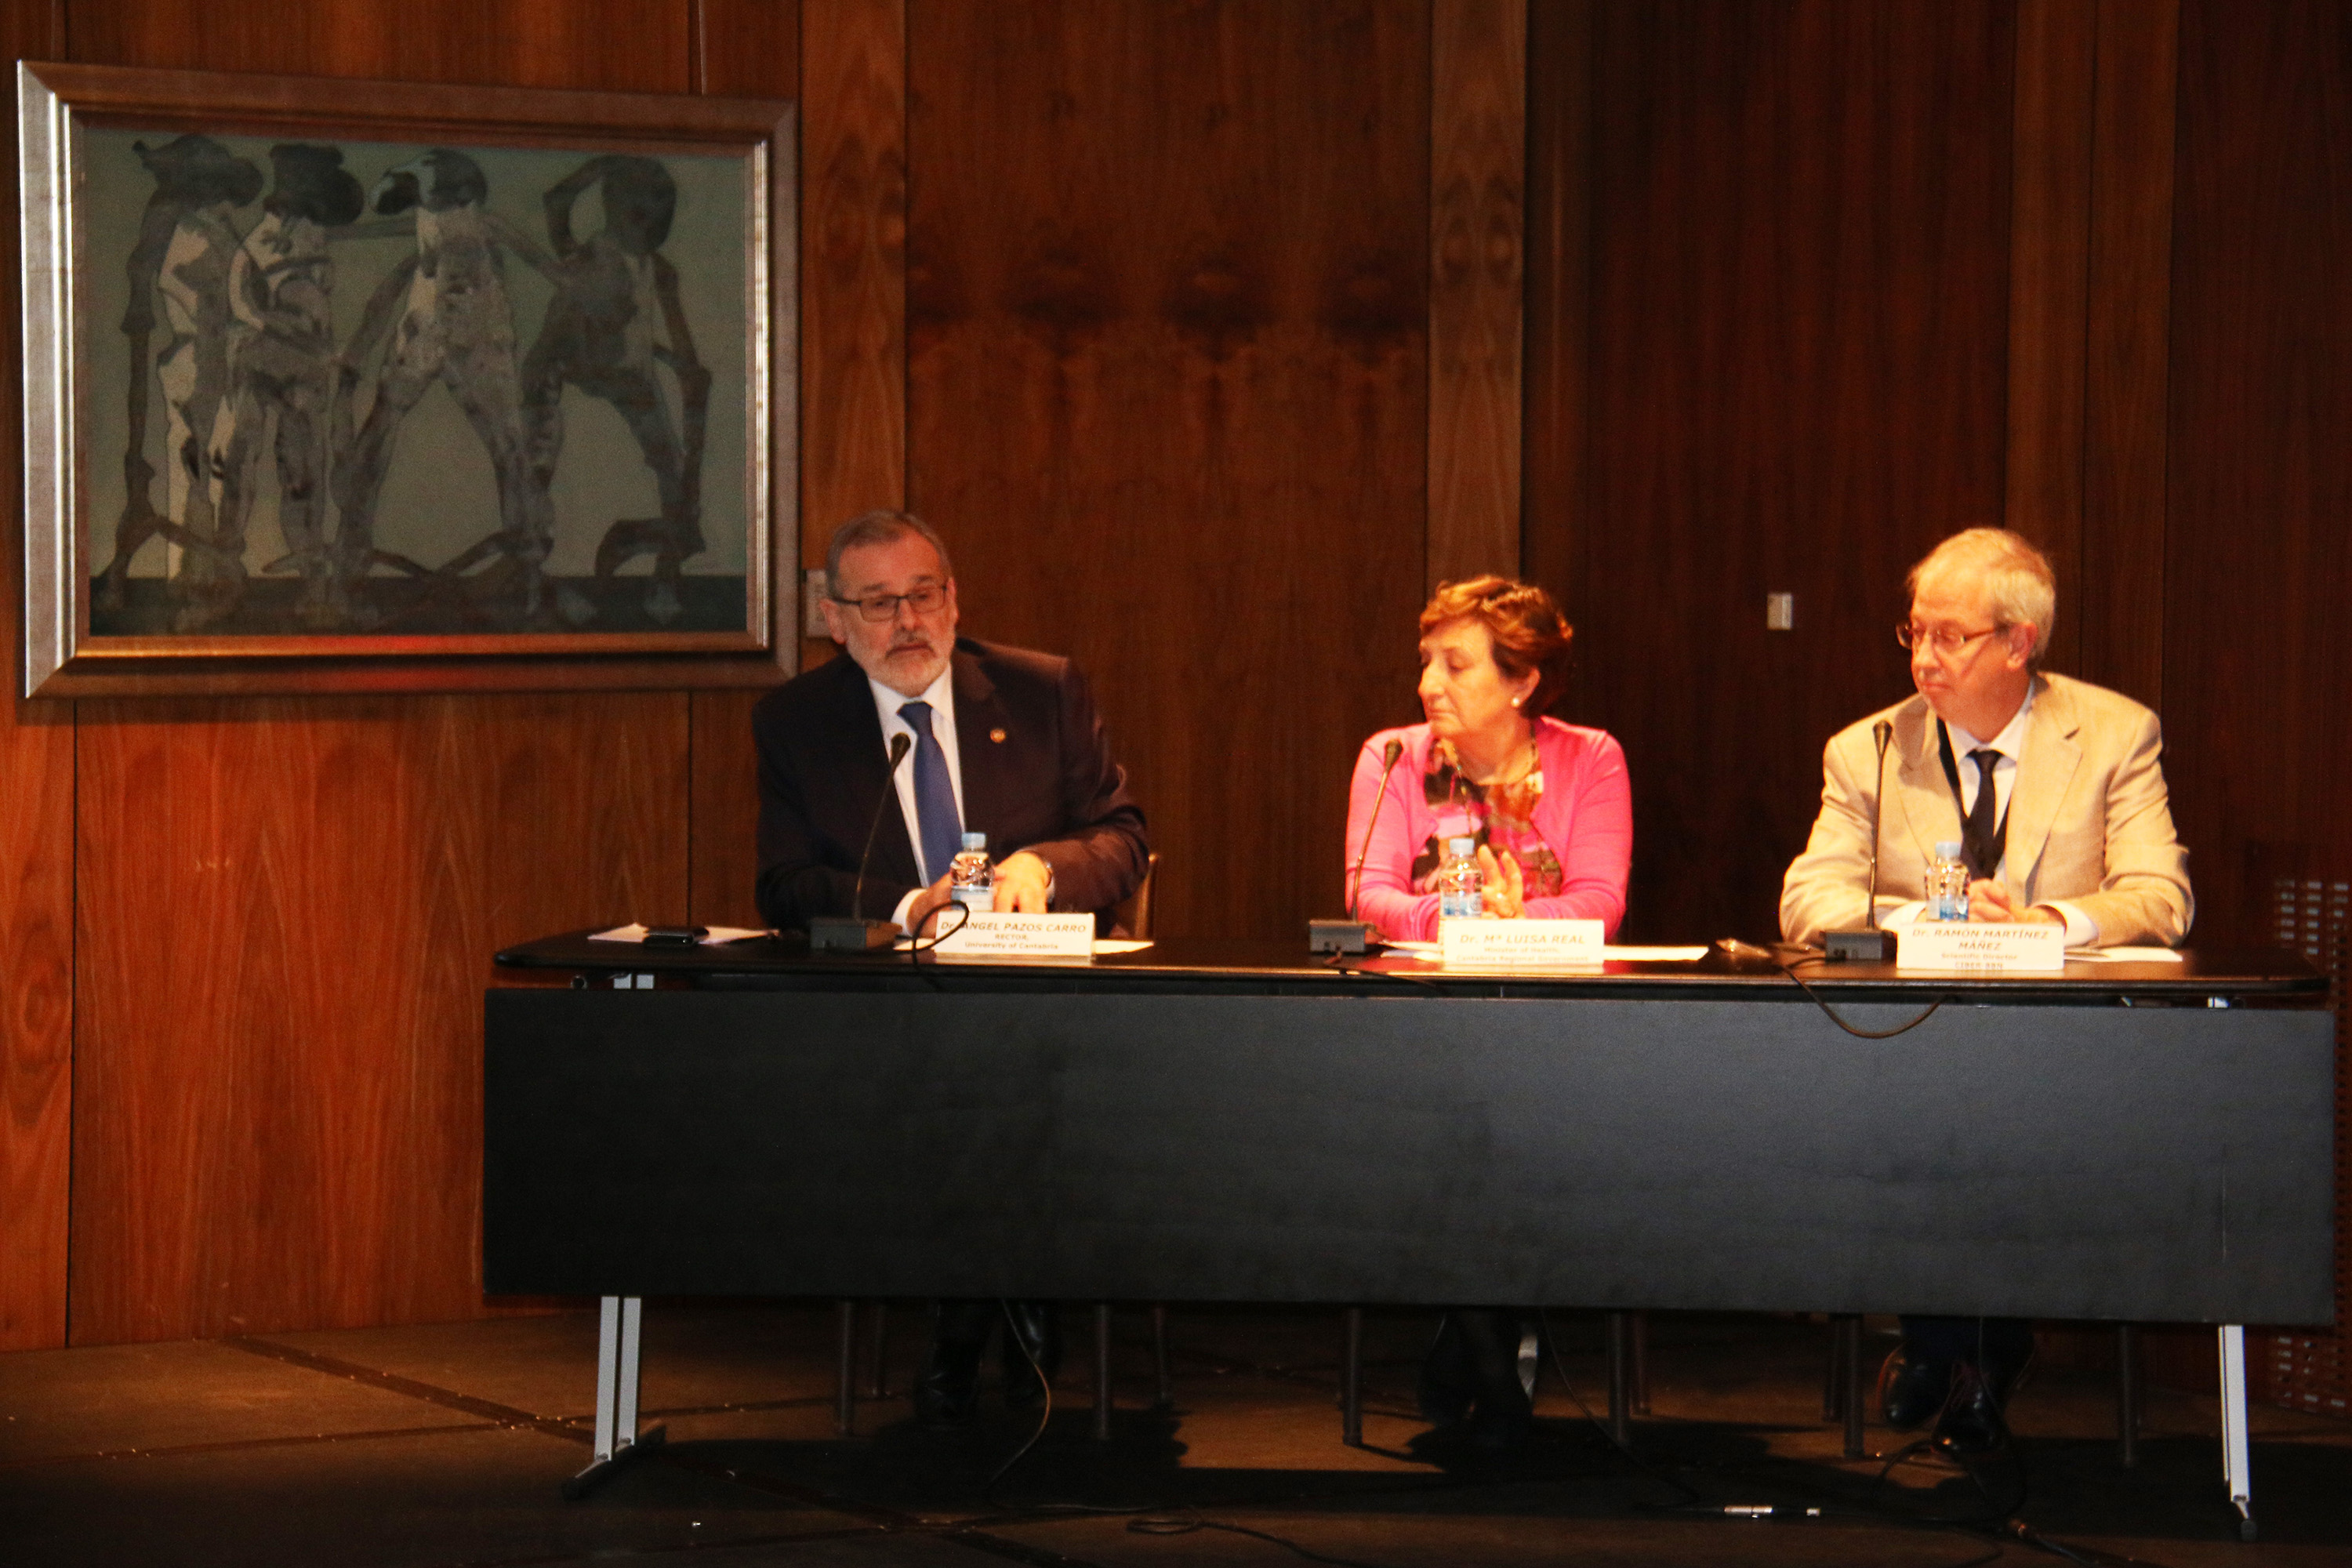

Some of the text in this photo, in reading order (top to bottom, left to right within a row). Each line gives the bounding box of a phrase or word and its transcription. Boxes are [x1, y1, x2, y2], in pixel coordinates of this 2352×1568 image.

[1004, 922, 1042, 931] PAZOS
[1046, 924, 1087, 933] CARRO
[1934, 927, 1980, 938] RAMÓN
[1983, 929, 2049, 940] MARTÍNEZ
[1506, 935, 1548, 945] LUISA
[1552, 935, 1587, 945] REAL
[1958, 941, 2002, 951] MÁÑEZ
